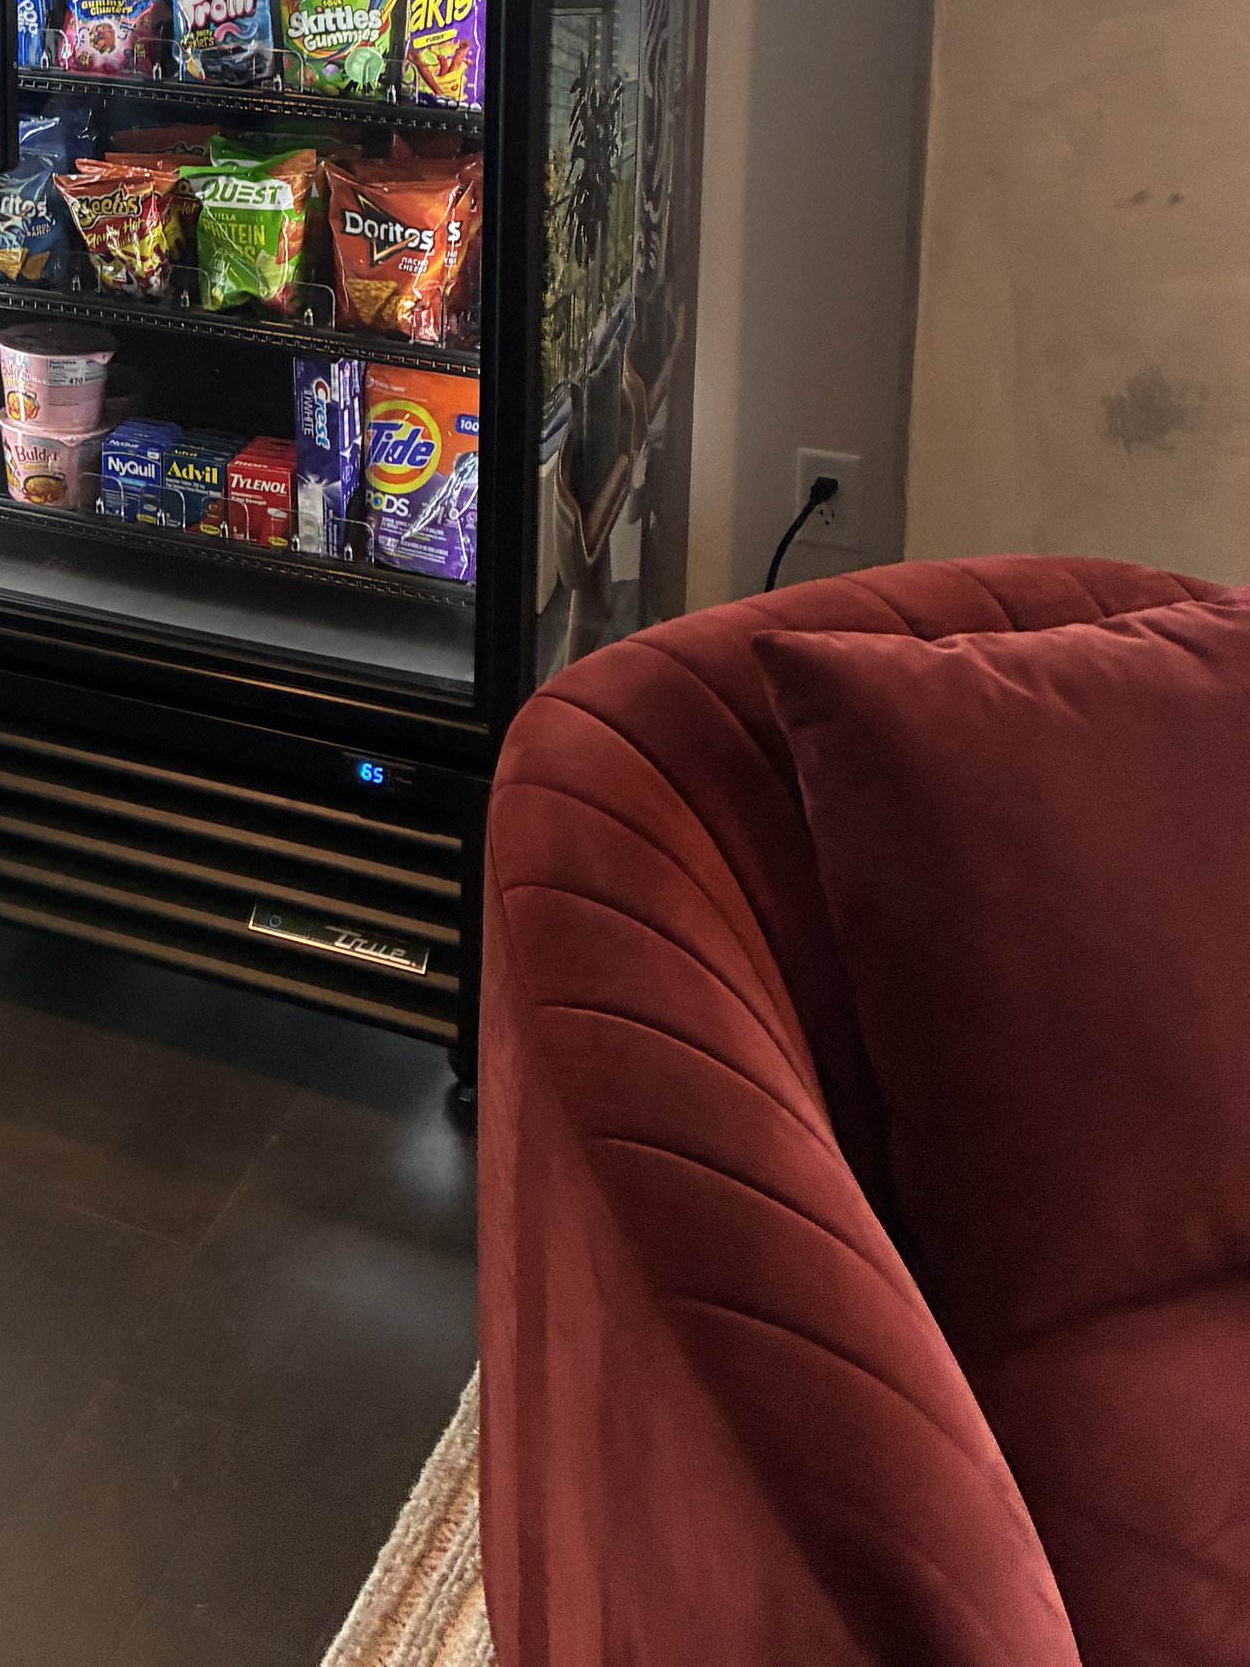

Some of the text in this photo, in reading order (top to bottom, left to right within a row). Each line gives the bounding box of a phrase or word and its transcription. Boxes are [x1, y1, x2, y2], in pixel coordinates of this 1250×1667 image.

[81, 0, 124, 10] Gummy
[90, 5, 132, 16] Clusters
[288, 5, 383, 37] Skittles
[304, 28, 380, 52] Gummies
[202, 178, 283, 205] QUEST
[345, 211, 434, 251] Doritos
[313, 377, 331, 451] Crest
[460, 419, 479, 433] 100
[366, 420, 435, 468] Tide
[108, 456, 155, 479] NyQuil
[168, 461, 218, 485] Advil
[230, 473, 287, 494] TYLENOL
[366, 490, 410, 517] PODS
[359, 763, 384, 784] 65
